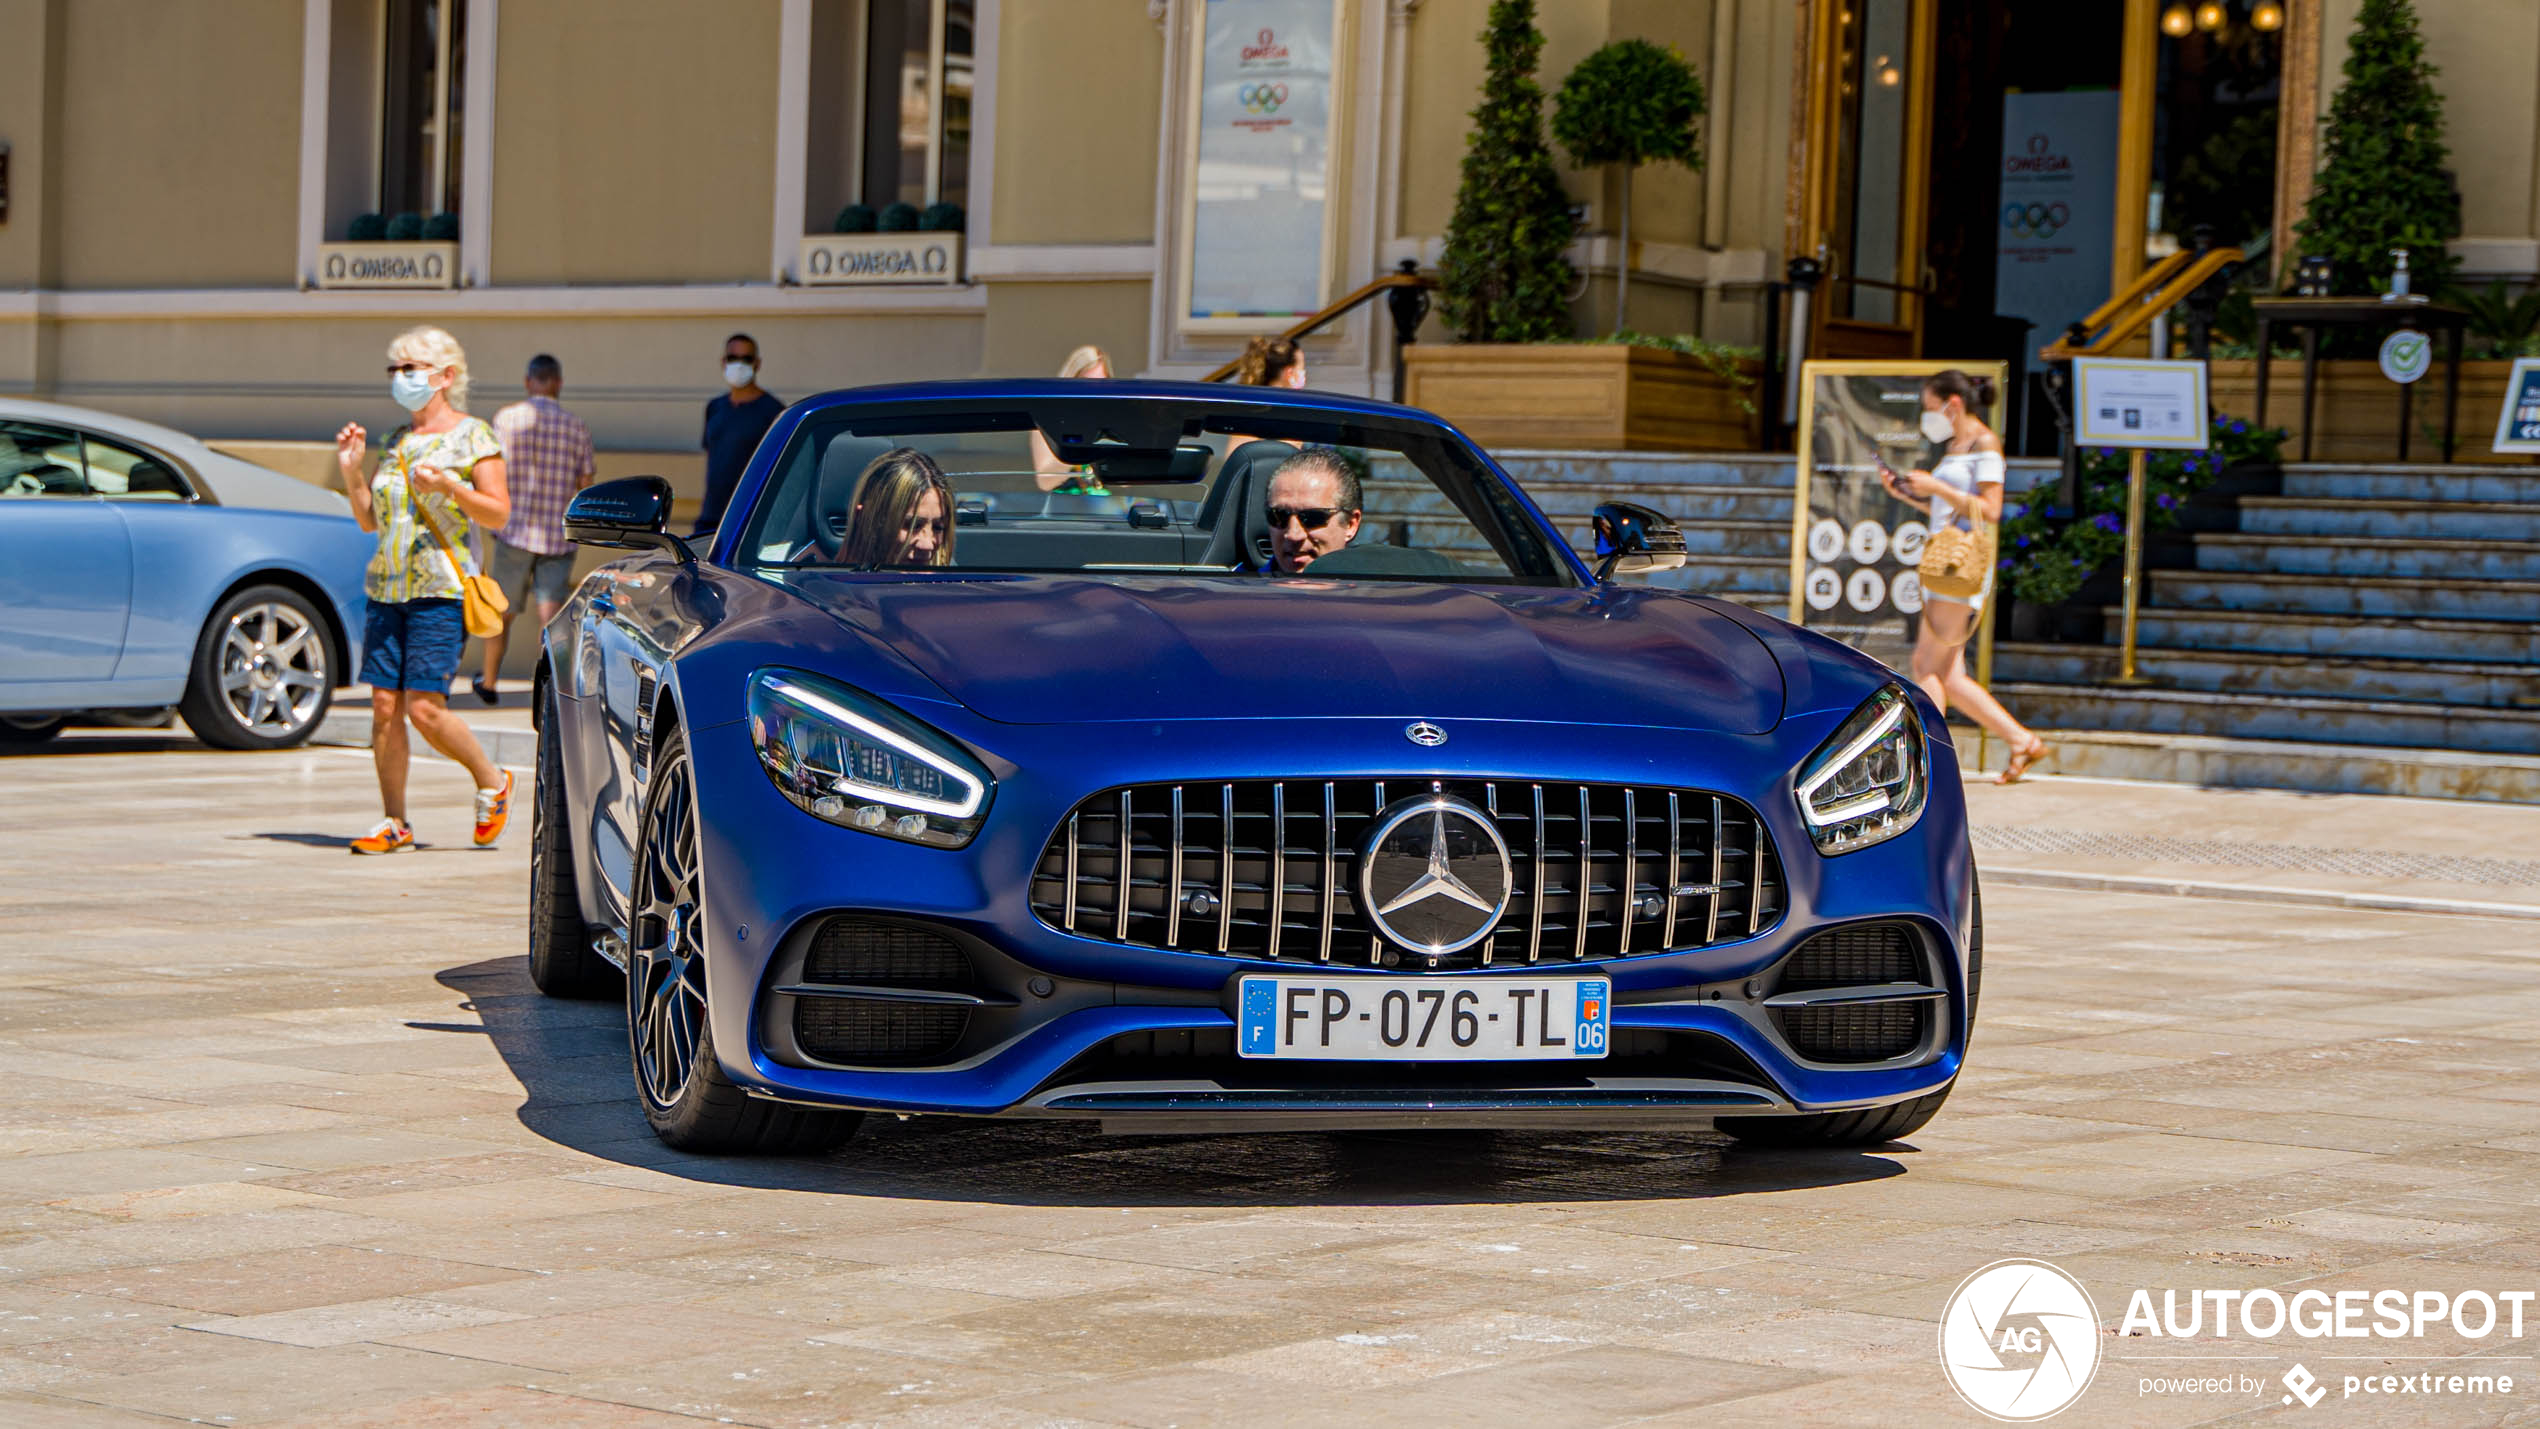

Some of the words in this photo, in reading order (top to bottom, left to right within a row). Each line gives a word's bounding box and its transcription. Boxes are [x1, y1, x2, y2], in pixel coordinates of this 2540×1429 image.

[2006, 156, 2070, 172] OMEGA
[350, 255, 418, 279] OMEGA
[838, 249, 917, 275] OMEGA
[1285, 987, 1566, 1048] FP-076-TL
[1254, 1026, 1264, 1042] F
[1578, 1022, 1604, 1049] 06
